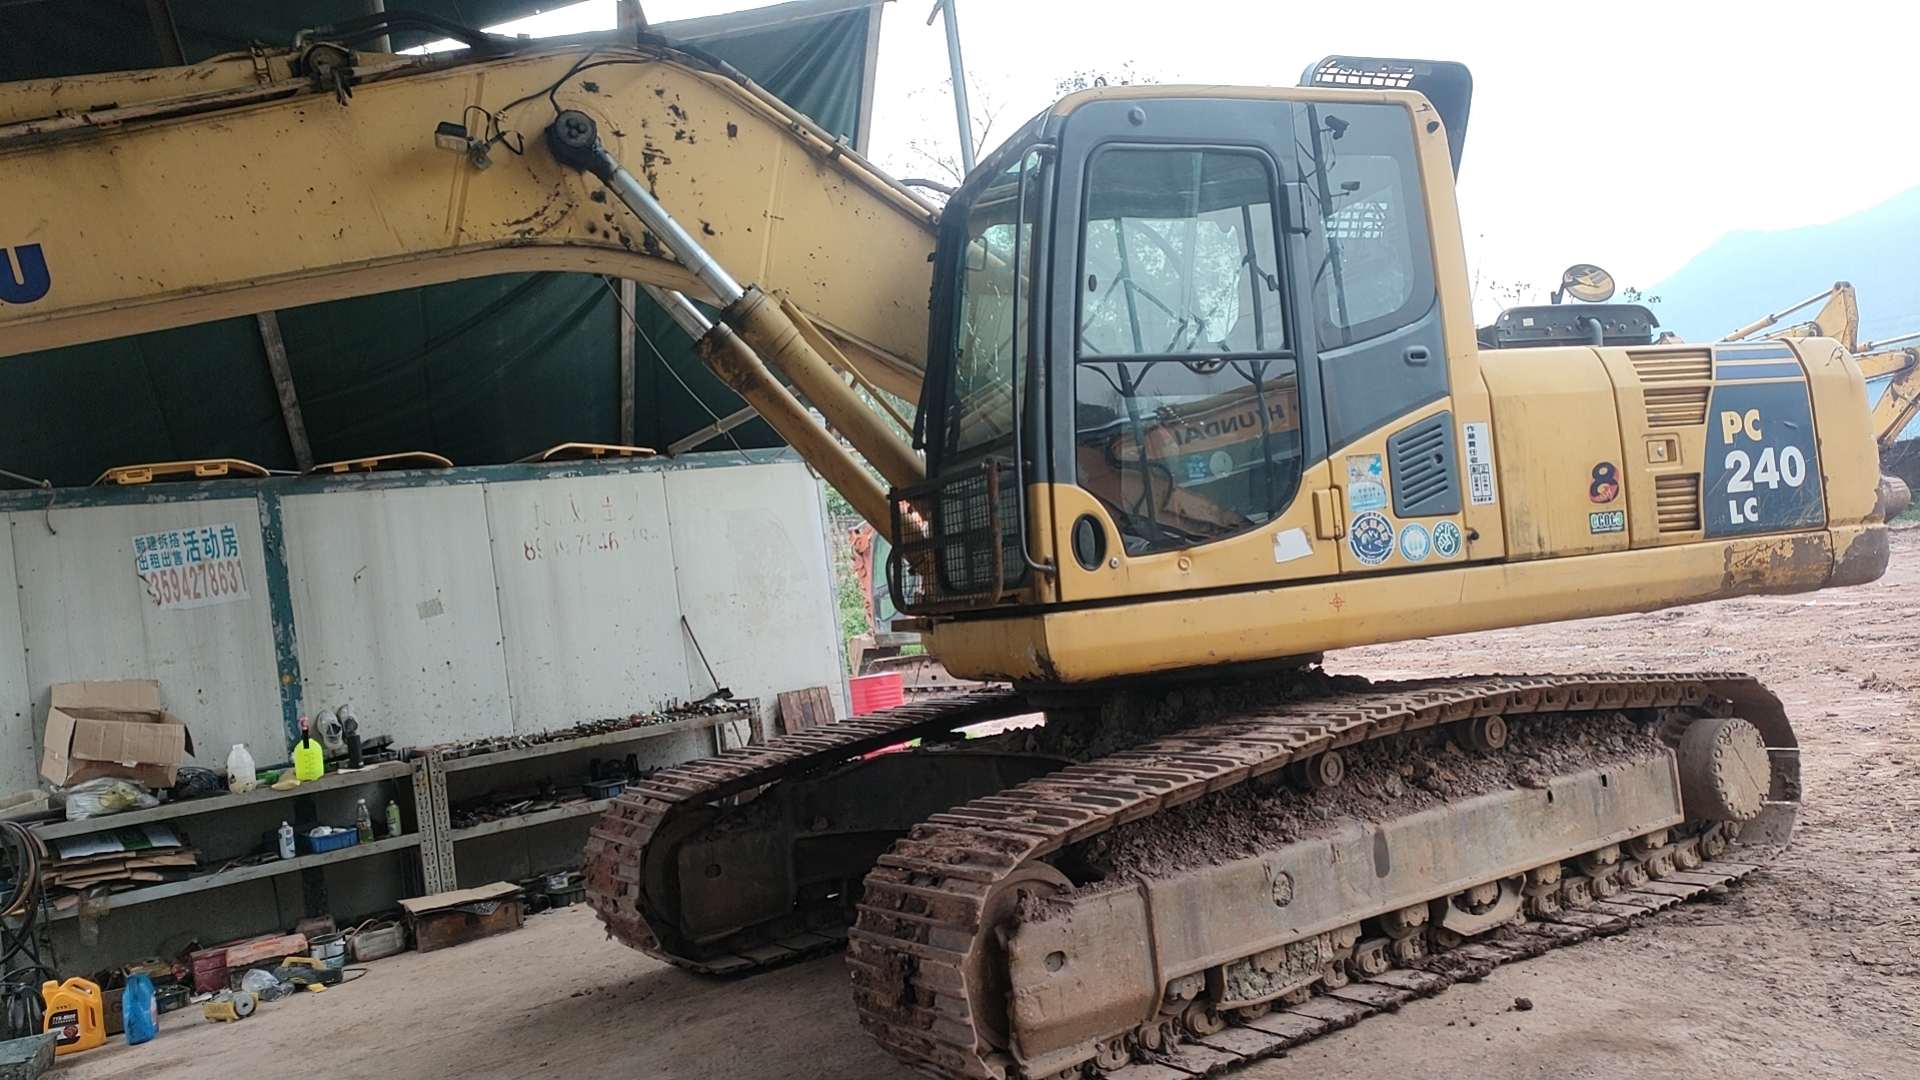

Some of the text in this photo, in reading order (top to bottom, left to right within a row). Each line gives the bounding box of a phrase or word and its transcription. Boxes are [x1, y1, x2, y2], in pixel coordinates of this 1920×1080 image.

[1720, 408, 1762, 445] PC
[1590, 462, 1619, 503] 8
[1724, 446, 1806, 493] 240
[1728, 497, 1759, 524] LC
[138, 549, 182, 571] 出租出售
[182, 525, 238, 562] 活动房
